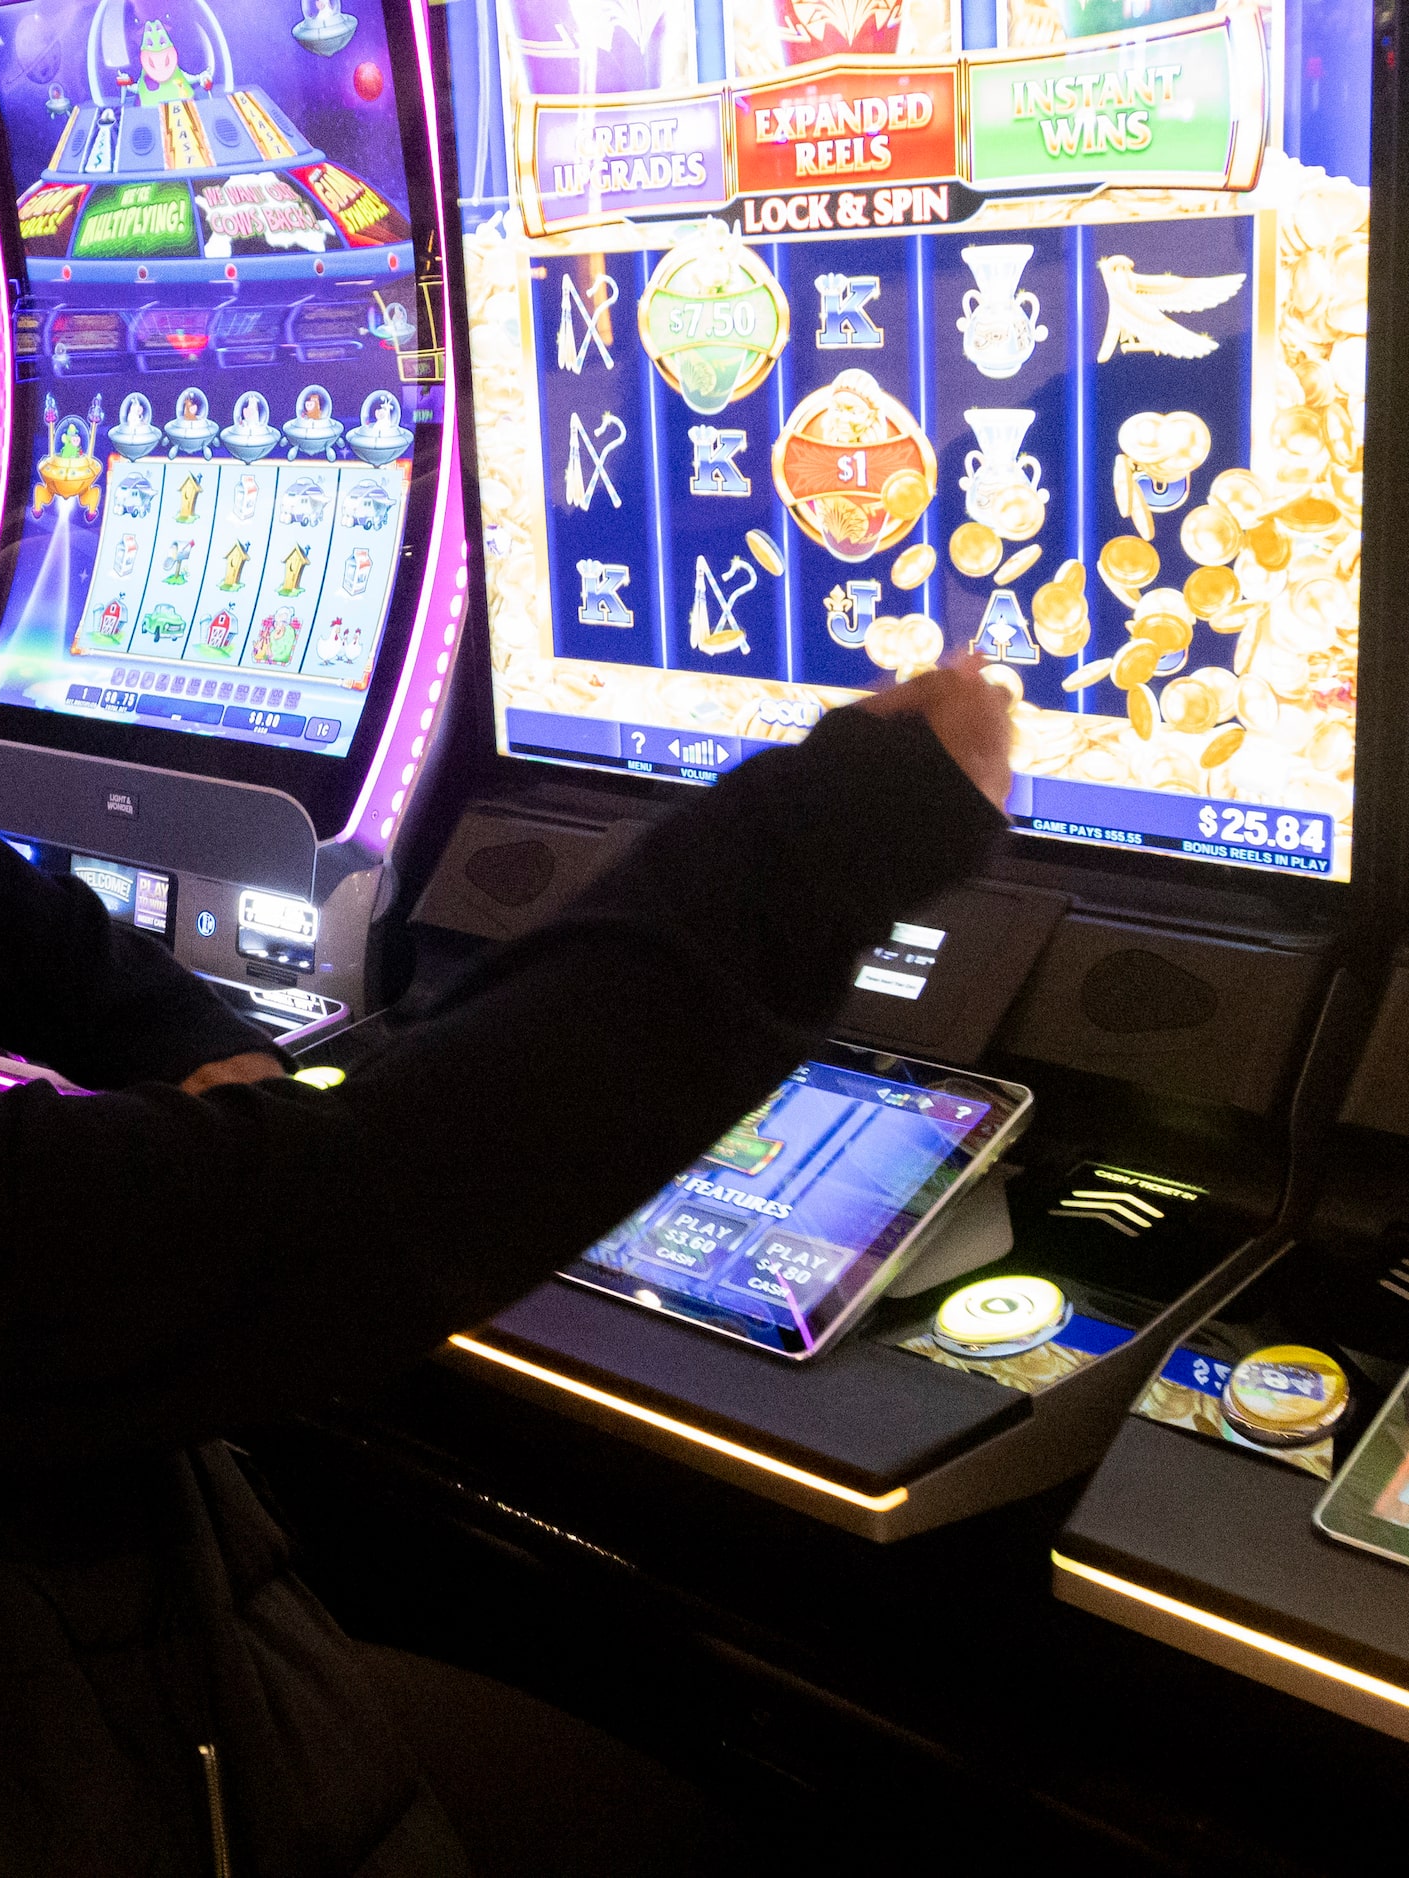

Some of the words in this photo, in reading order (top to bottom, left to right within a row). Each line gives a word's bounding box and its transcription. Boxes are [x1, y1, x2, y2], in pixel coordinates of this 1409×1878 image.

[1012, 65, 1182, 118] INSTANT
[755, 92, 933, 143] EXPANDED
[173, 105, 193, 164] BLAST
[1039, 110, 1152, 158] WINS
[795, 135, 892, 177] REELS
[554, 152, 707, 195] UPGRADES
[202, 185, 225, 207] WE
[225, 184, 265, 204] WANT
[265, 182, 302, 201] OUR
[744, 194, 833, 233] LOCK
[836, 191, 870, 229] &
[873, 185, 949, 225] SPIN
[80, 199, 186, 248] MULTIPLYING!
[210, 206, 264, 238] COWS
[260, 202, 321, 233] BACK!
[669, 301, 756, 337] $7.50
[837, 451, 868, 487] $1
[248, 711, 281, 728] $0.00
[627, 760, 653, 772] MENU
[680, 767, 719, 782] VOLUME
[107, 801, 134, 815] WONDER
[109, 793, 126, 805] LIGHT
[1032, 819, 1067, 836] GAME
[1069, 824, 1103, 840] PAYS
[1105, 829, 1142, 846] $55.55
[1198, 805, 1326, 854] $25.84
[1182, 839, 1228, 859] BONUS
[1229, 845, 1273, 865] REELS
[1275, 853, 1289, 867] IN
[1291, 856, 1329, 873] PLAY
[76, 871, 131, 899] WELCOME!
[139, 878, 170, 900] PLAY
[684, 1177, 793, 1220] FEATURES
[664, 1229, 717, 1255] $3.60
[674, 1213, 733, 1240] PLAY
[656, 1246, 696, 1267] CASH
[766, 1242, 828, 1269] PLAY
[747, 1277, 791, 1298] CASH
